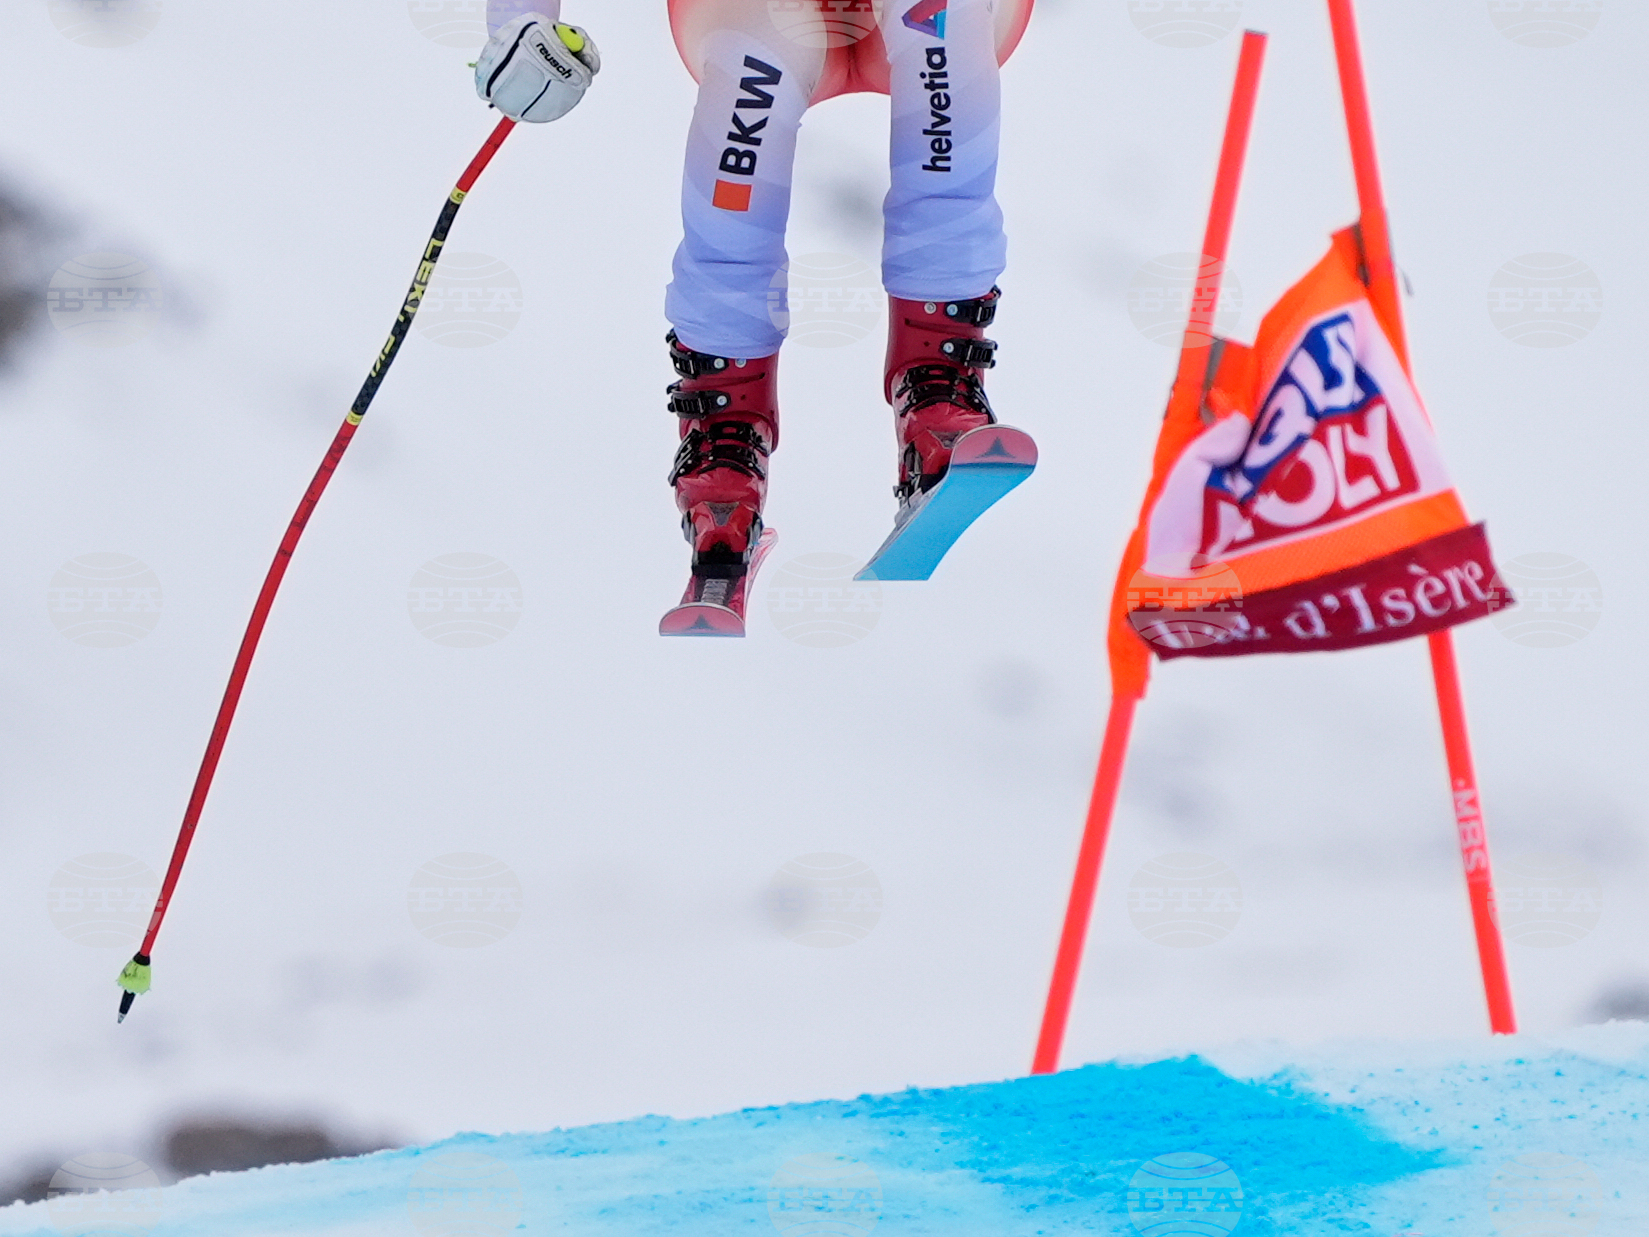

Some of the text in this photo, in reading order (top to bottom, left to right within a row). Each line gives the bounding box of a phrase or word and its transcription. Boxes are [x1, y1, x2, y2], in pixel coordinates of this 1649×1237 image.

[536, 42, 573, 79] reusch
[719, 54, 783, 176] BKW
[919, 47, 952, 173] helvetia
